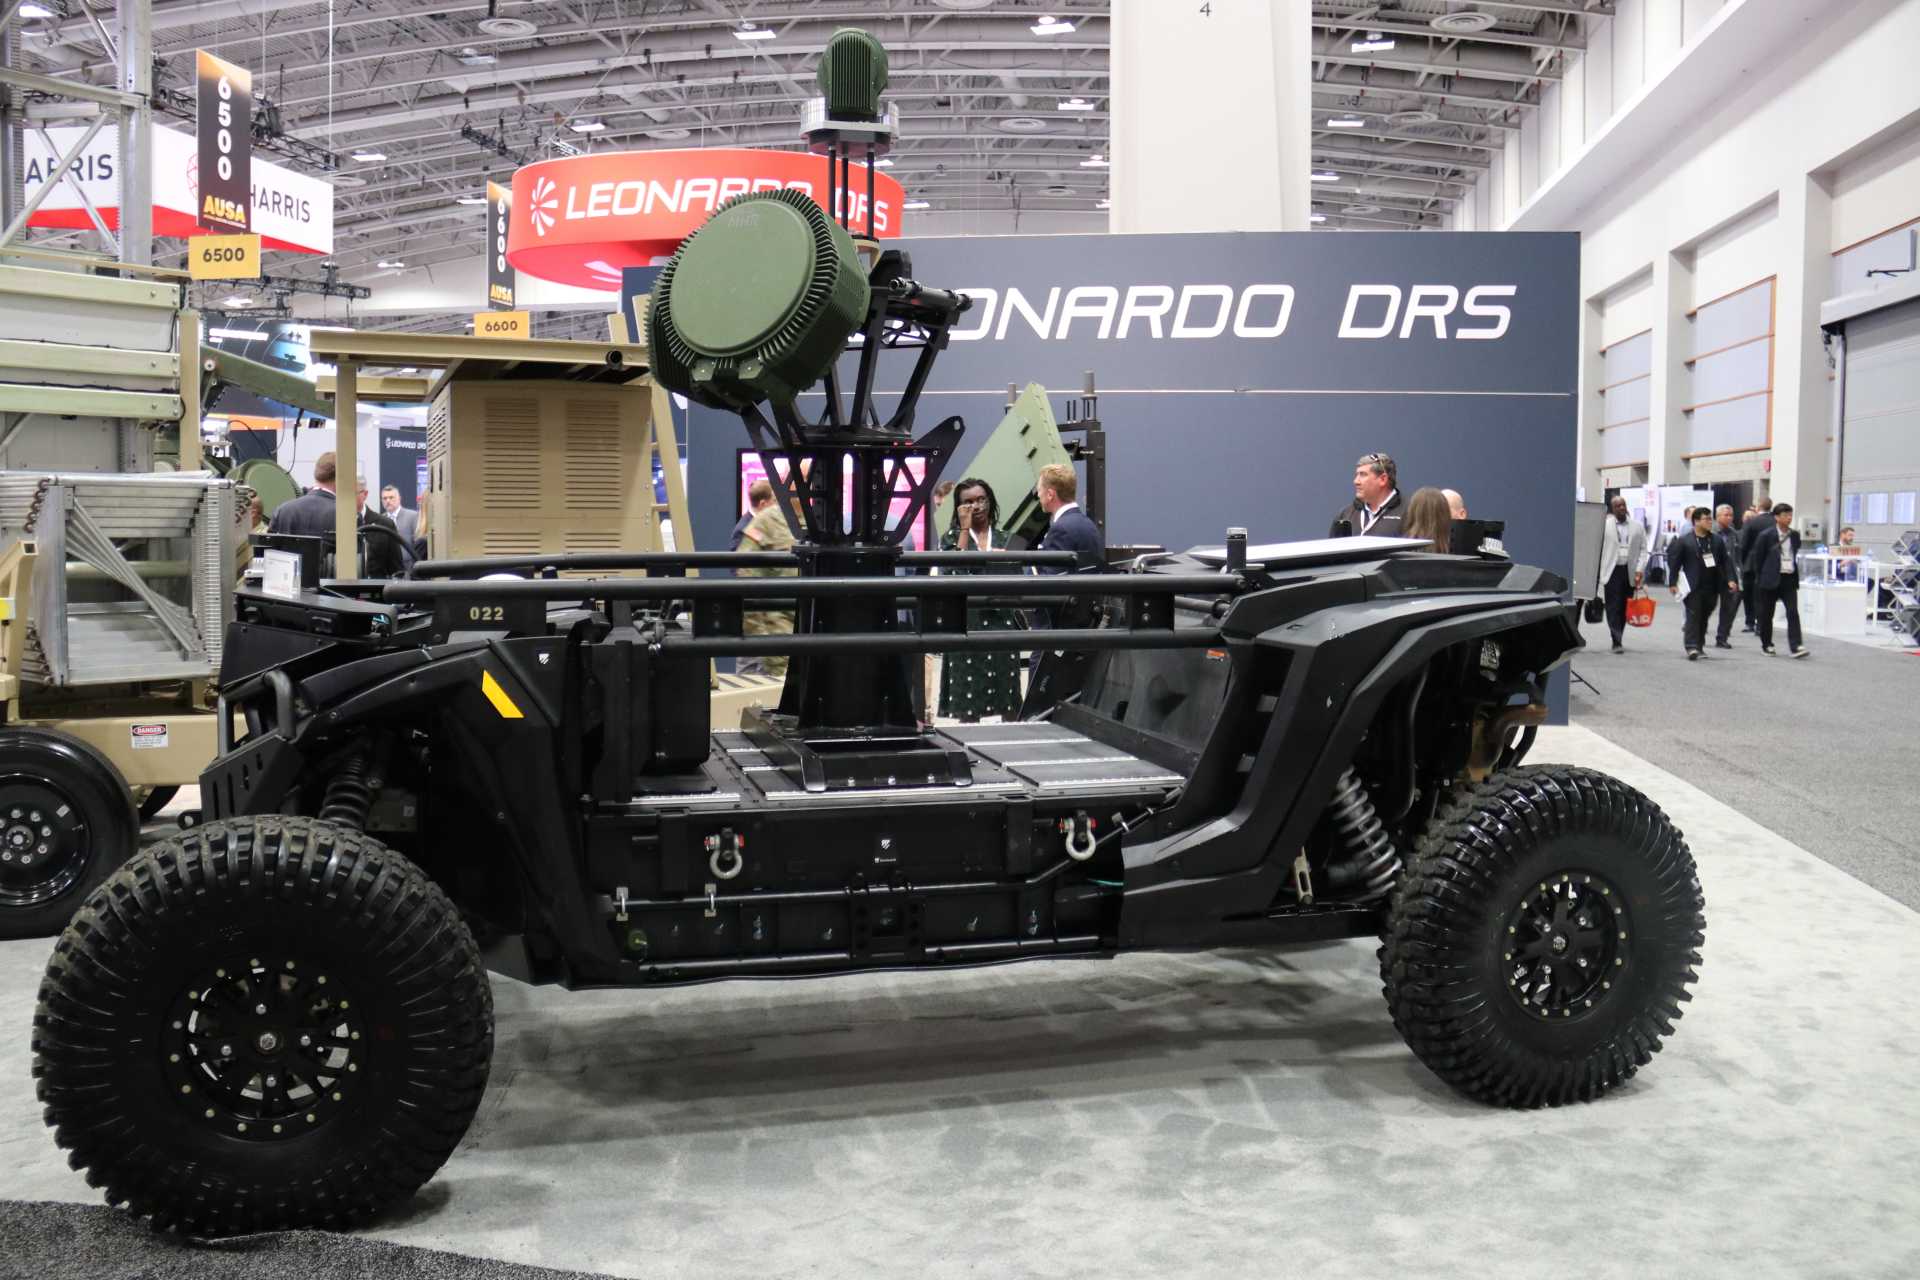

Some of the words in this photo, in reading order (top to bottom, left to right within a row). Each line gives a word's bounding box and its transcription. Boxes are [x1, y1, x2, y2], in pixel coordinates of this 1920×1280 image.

[1200, 2, 1212, 16] 4
[218, 77, 232, 181] 6500
[203, 195, 246, 223] AUSA
[497, 198, 505, 273] 6600
[203, 247, 245, 262] 6500
[490, 283, 513, 303] AUSA
[880, 284, 1296, 341] ONARDO
[1338, 284, 1518, 339] DRS
[485, 320, 518, 332] 6600
[470, 606, 504, 620] 022
